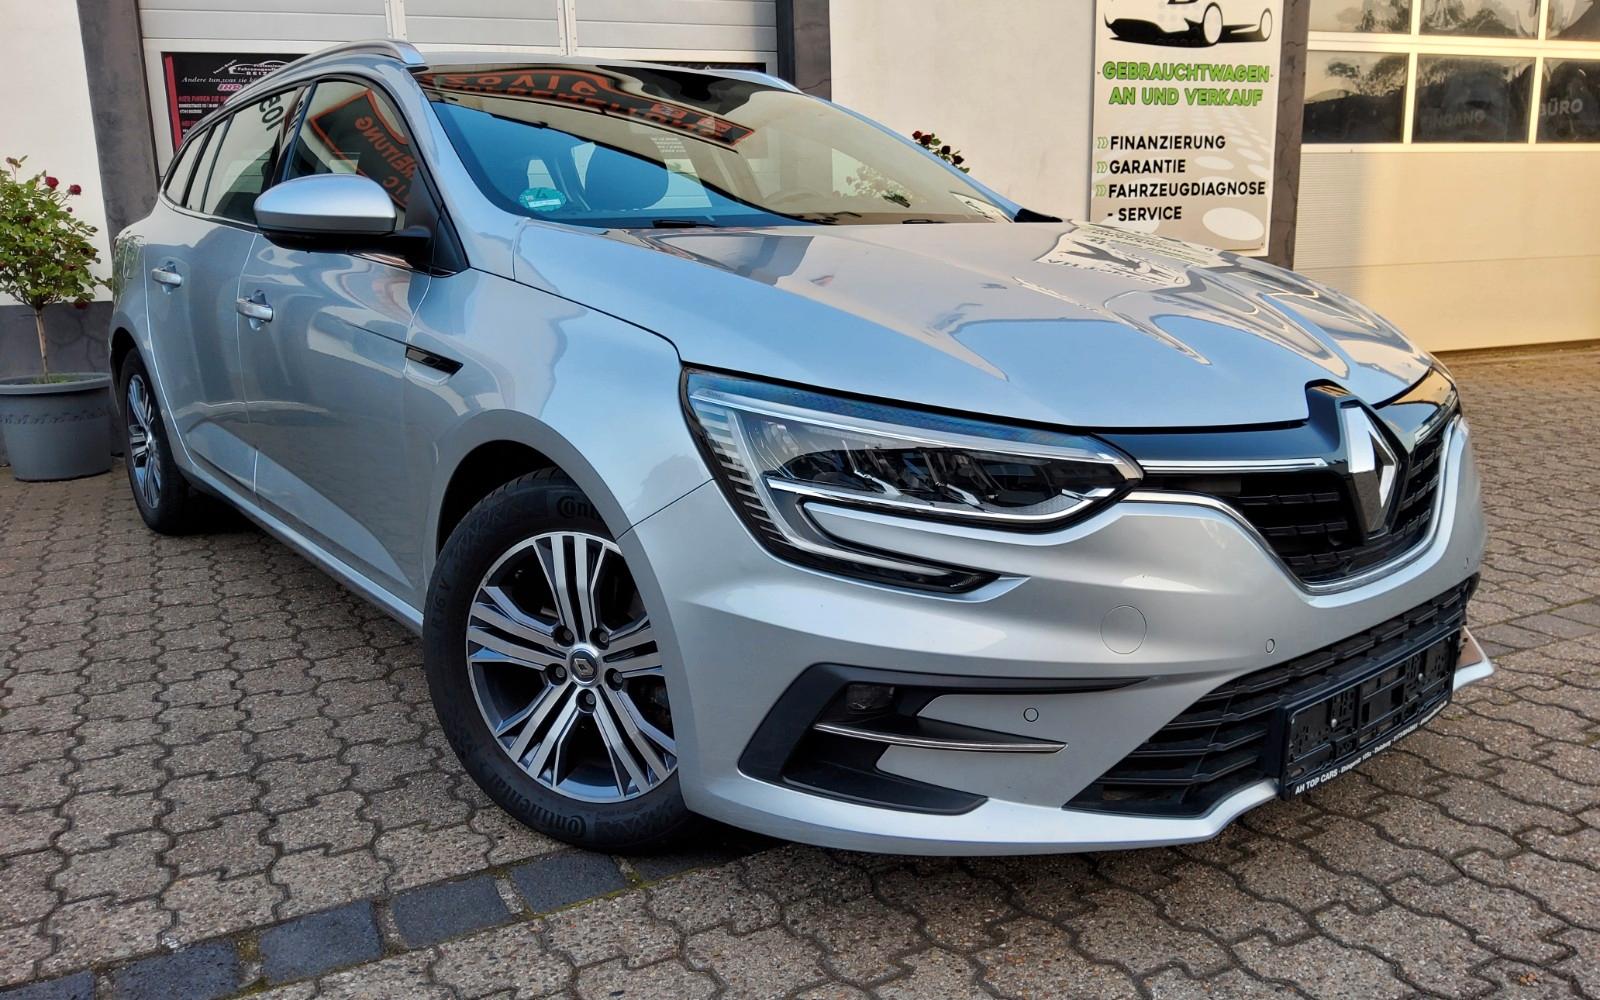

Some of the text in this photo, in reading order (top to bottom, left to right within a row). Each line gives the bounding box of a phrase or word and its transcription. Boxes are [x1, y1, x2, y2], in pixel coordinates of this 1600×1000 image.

[1102, 61, 1270, 83] GEBRAUCHTWAGEN
[1109, 86, 1263, 107] AN UND VERKAUF
[1110, 135, 1226, 150] FINANZIERUNG
[1109, 159, 1186, 174] GARANTIE
[1108, 181, 1266, 198] FAHRZEUGDIAGNOSE
[1118, 206, 1182, 221] SERVICE
[1305, 777, 1320, 791] TOP
[1320, 768, 1338, 783] CARS
